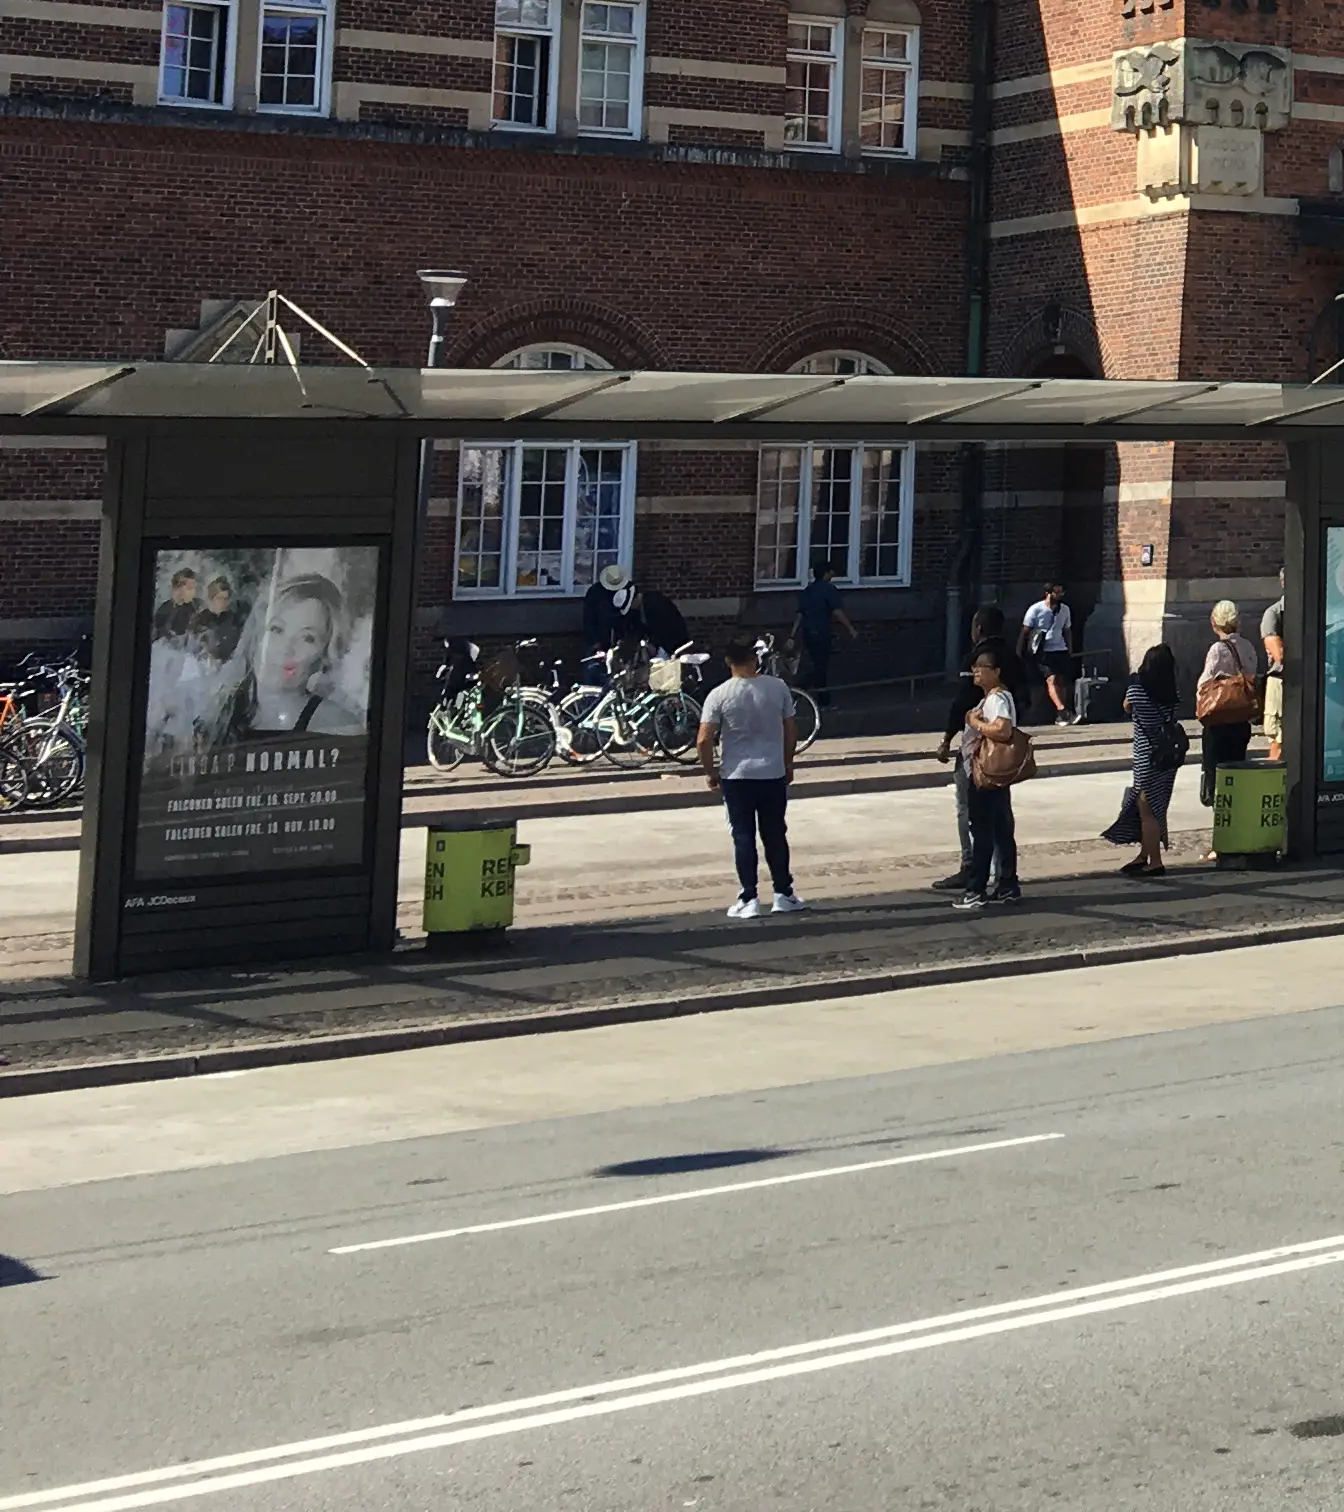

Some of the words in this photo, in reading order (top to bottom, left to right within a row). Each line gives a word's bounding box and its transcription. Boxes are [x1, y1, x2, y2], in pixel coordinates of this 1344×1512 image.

[227, 752, 235, 773] P
[246, 748, 340, 772] NORMAL?
[147, 895, 196, 906] JCDecaux
